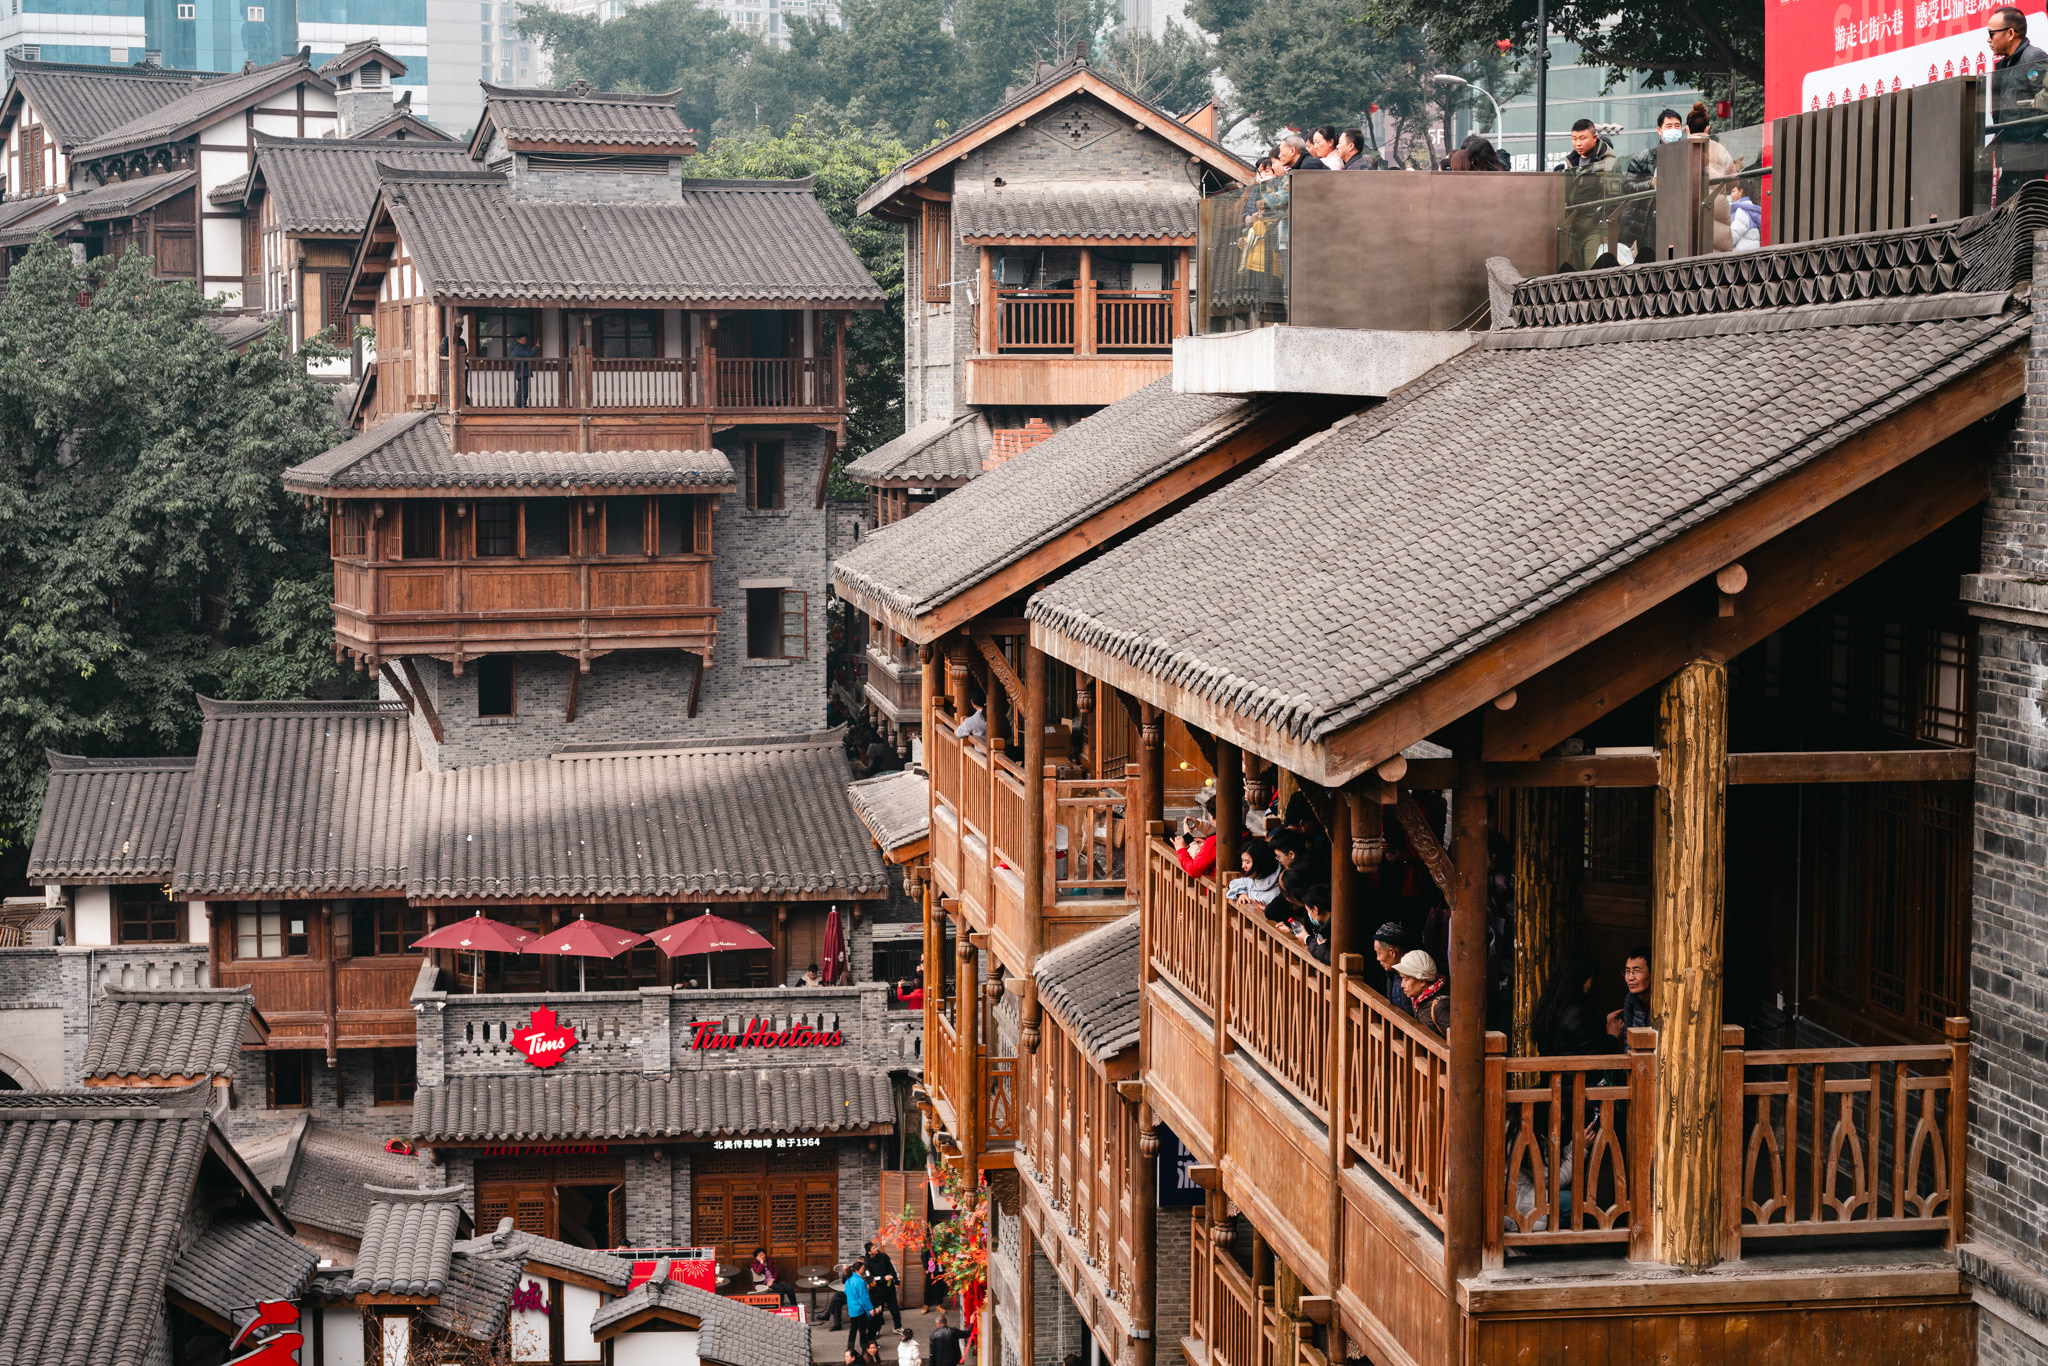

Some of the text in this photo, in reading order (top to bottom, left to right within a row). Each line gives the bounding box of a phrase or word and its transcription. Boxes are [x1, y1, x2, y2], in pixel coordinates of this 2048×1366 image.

[1834, 0, 2016, 52] 游走七街六巷 感受巴渝建
[524, 1032, 565, 1055] Tims
[689, 1018, 842, 1050] Tim Hortons
[713, 1137, 821, 1150] 北美传奇咖啡 始于1964
